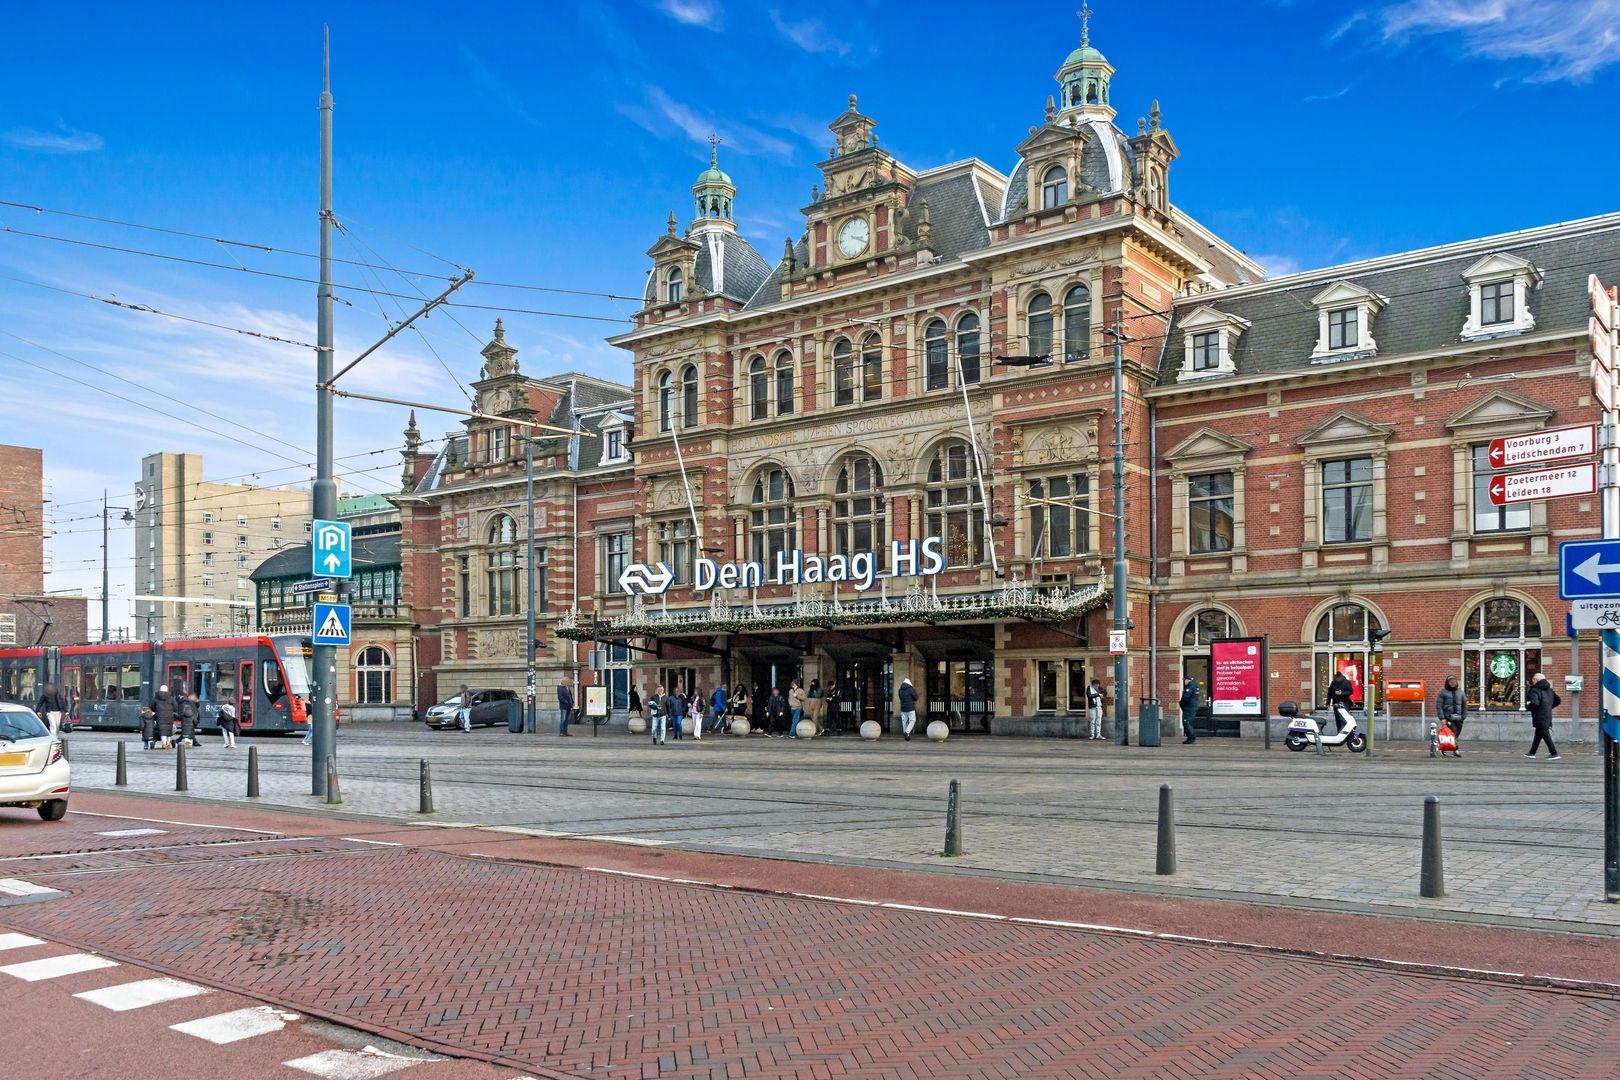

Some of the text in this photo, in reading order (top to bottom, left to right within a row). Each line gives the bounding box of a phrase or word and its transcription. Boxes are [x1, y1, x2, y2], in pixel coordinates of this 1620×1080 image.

[731, 429, 798, 452] HOLLANDSCHE
[846, 414, 904, 434] SPOORWEG
[1506, 434, 1560, 449] Voorburg 3
[1506, 444, 1576, 461] Leidschendam
[1507, 470, 1577, 486] Zoetermeer 12
[1507, 486, 1552, 498] Leiden 18
[326, 532, 338, 550] P
[694, 536, 945, 592] Den Haag HS
[298, 581, 325, 591] Stationsplein
